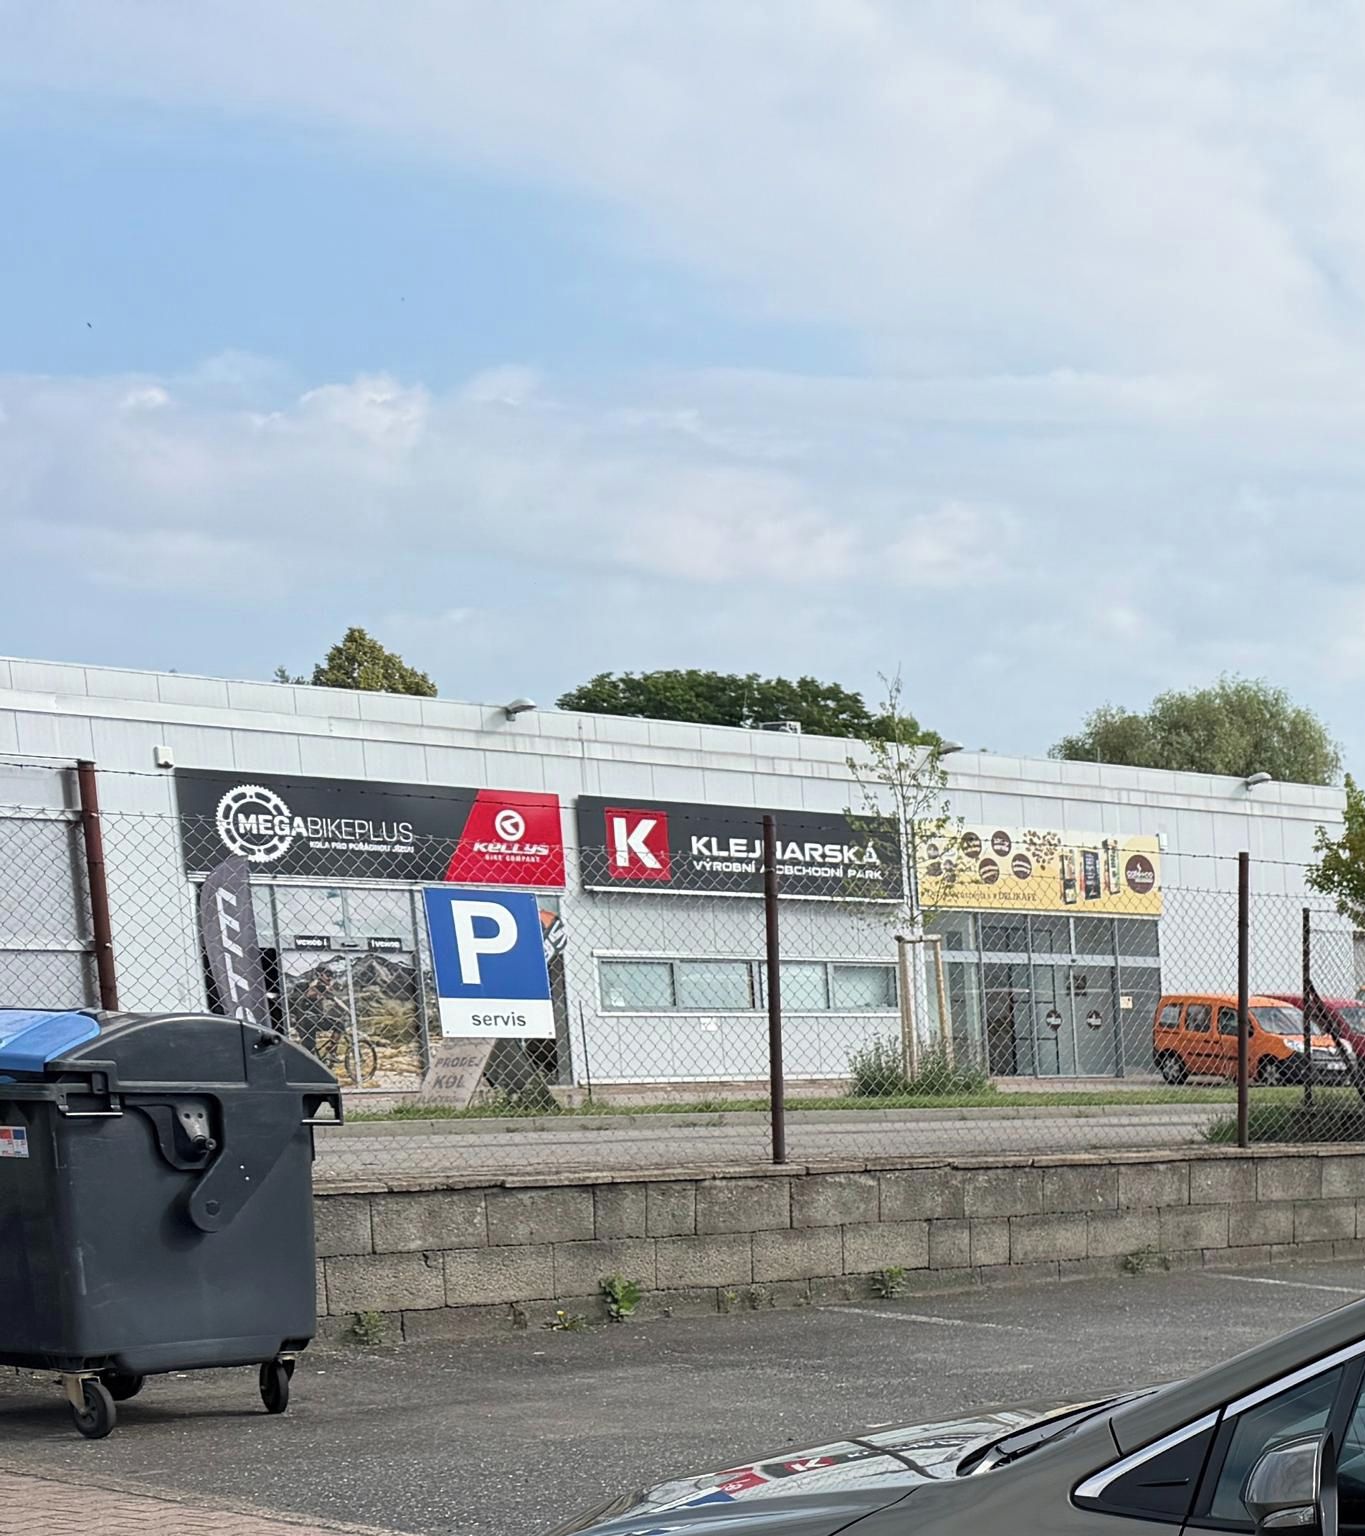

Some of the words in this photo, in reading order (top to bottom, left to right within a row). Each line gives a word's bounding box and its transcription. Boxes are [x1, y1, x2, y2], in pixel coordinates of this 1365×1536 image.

[237, 813, 414, 843] MEGABIKEPLUS
[612, 816, 662, 869] K
[505, 854, 540, 863] COMPANY
[692, 857, 756, 874] VÝROBNÍ
[847, 868, 884, 881] PARK
[450, 899, 518, 985] P
[471, 1011, 527, 1027] servis
